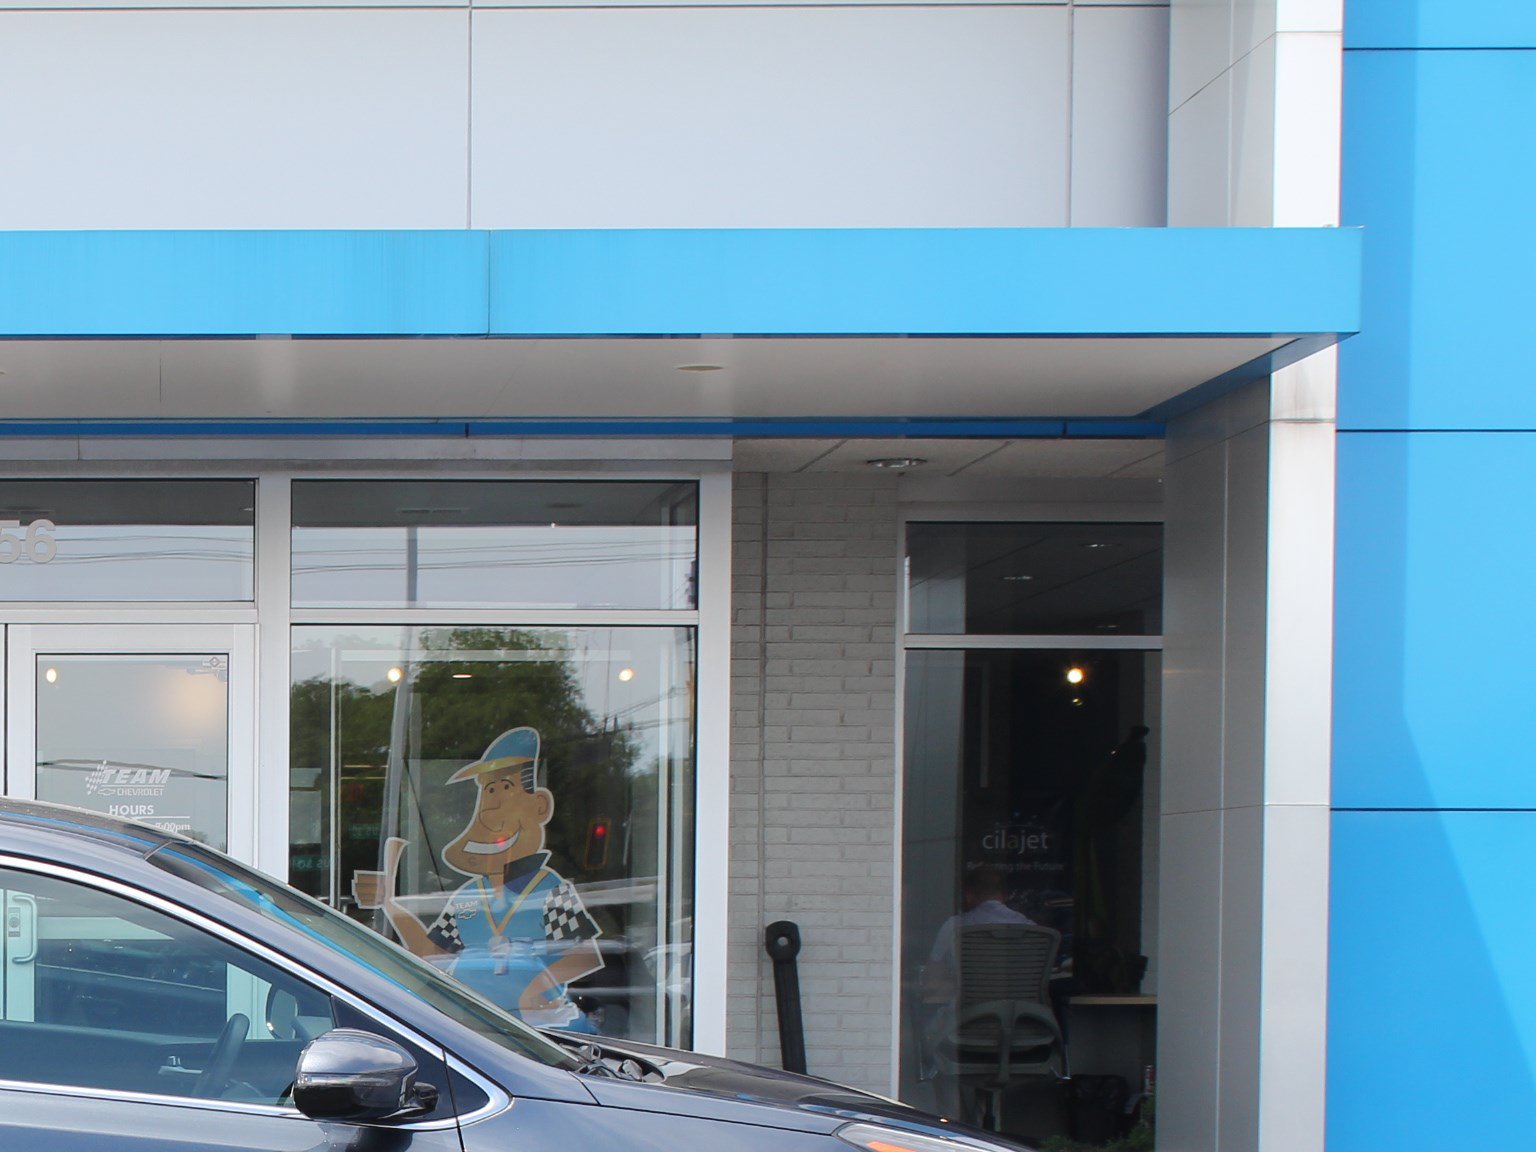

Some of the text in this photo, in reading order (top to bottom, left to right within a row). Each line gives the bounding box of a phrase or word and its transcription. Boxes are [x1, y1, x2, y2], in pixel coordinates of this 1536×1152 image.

[101, 769, 172, 784] TEAM
[116, 787, 165, 796] CHEVROLET
[109, 804, 154, 816] HOURS
[982, 829, 1049, 855] cilajet
